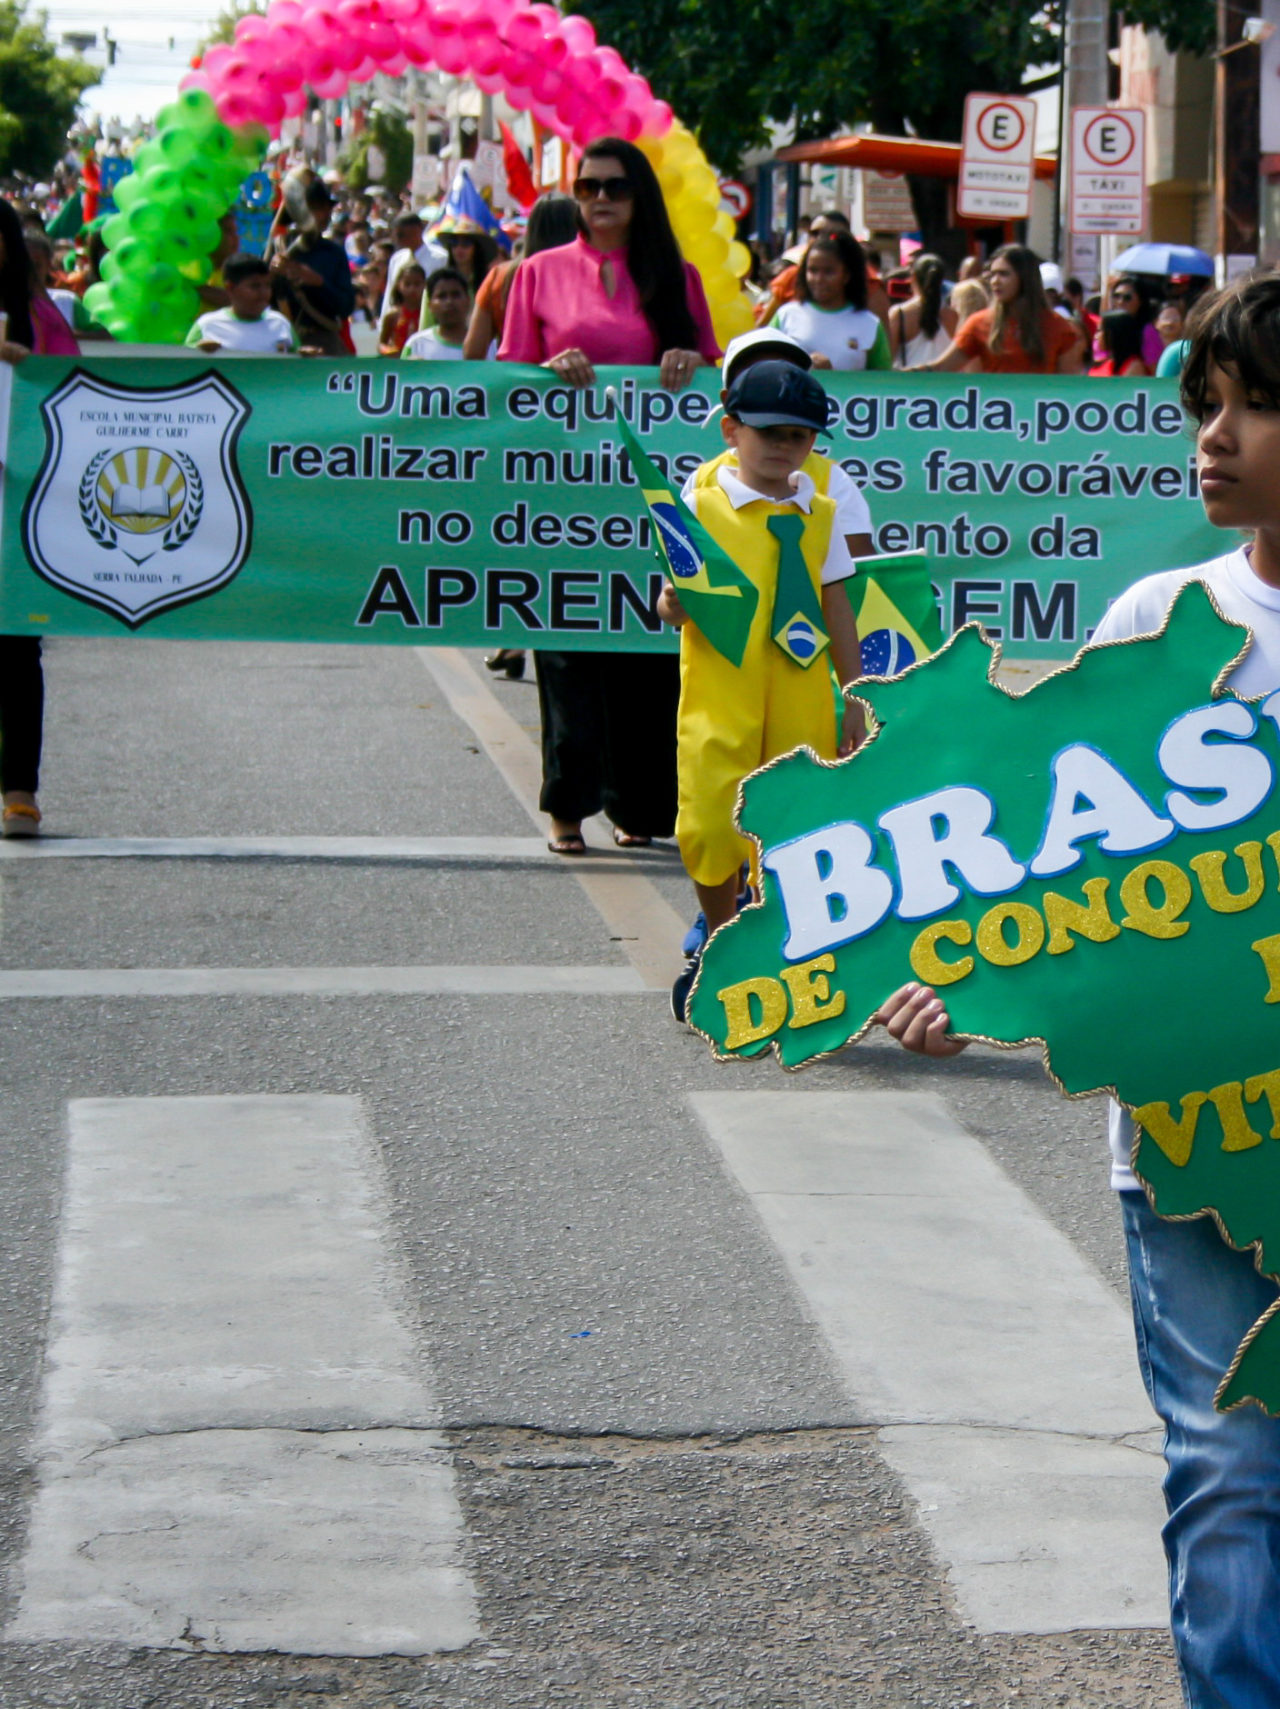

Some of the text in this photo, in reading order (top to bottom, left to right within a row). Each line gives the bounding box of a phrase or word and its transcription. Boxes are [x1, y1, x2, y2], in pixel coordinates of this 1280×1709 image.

[992, 115, 1009, 140] E
[1100, 127, 1116, 152] E
[79, 410, 217, 425] ESCOLA MUNICIPAL BATISTA
[506, 378, 712, 434] equipe
[96, 425, 150, 438] GUILHERME
[268, 433, 486, 482] realizar
[398, 508, 473, 545] no
[1028, 513, 1104, 560] da
[93, 572, 120, 583] SERRA
[123, 573, 163, 584] TALHADA
[716, 953, 846, 1050] DE
